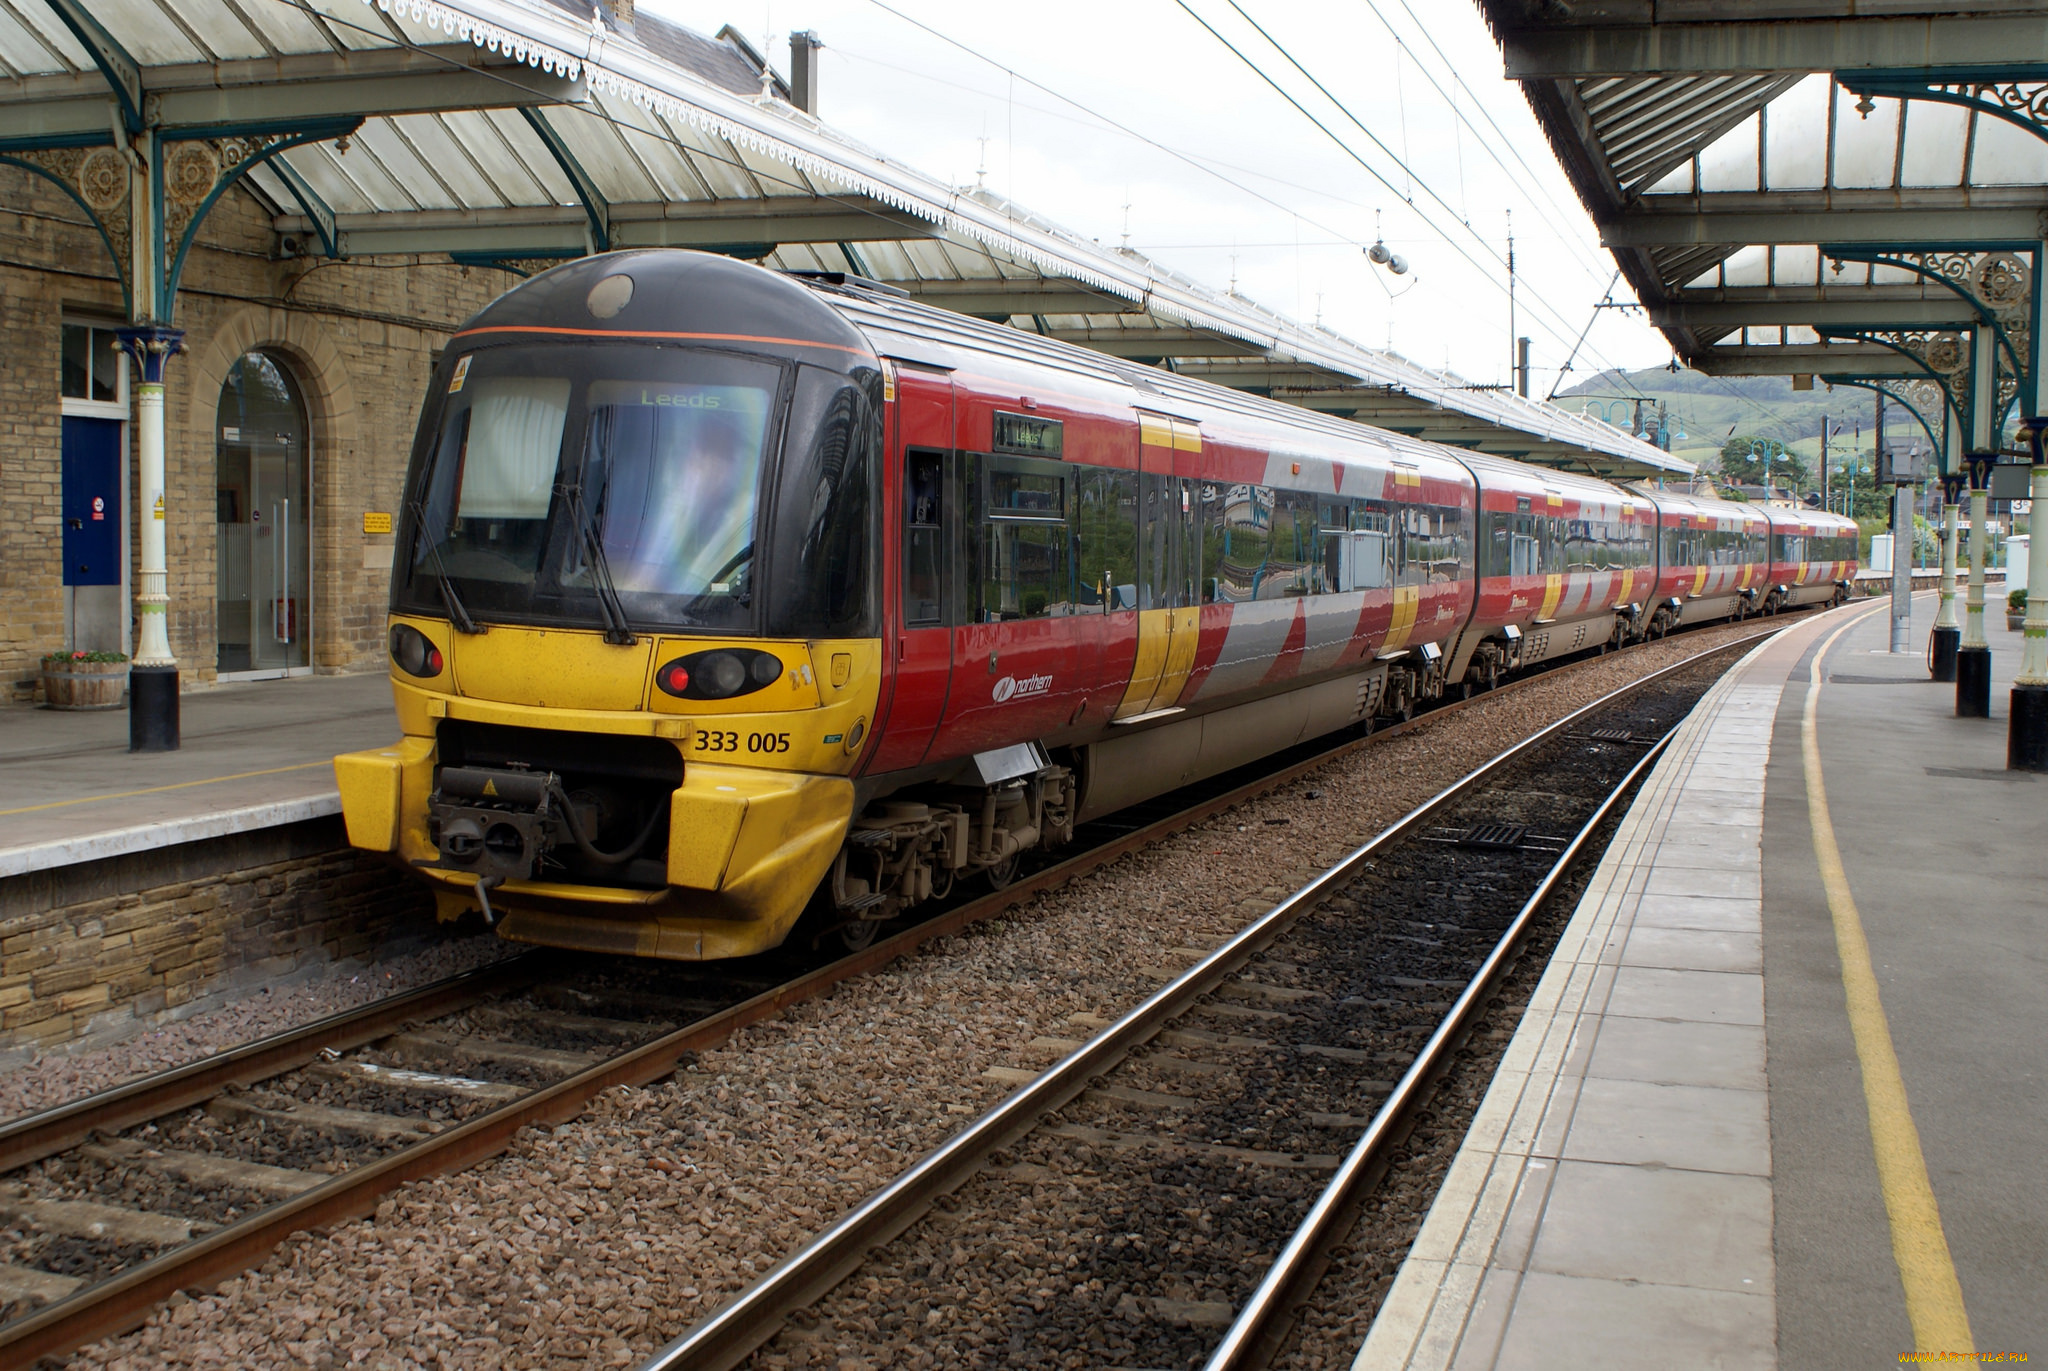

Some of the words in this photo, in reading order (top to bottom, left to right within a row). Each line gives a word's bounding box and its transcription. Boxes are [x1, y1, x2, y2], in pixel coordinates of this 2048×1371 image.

[641, 389, 721, 409] Leeds
[1016, 429, 1039, 444] Leeds
[1014, 673, 1053, 694] northern
[695, 730, 739, 752] 333
[747, 732, 791, 753] 005
